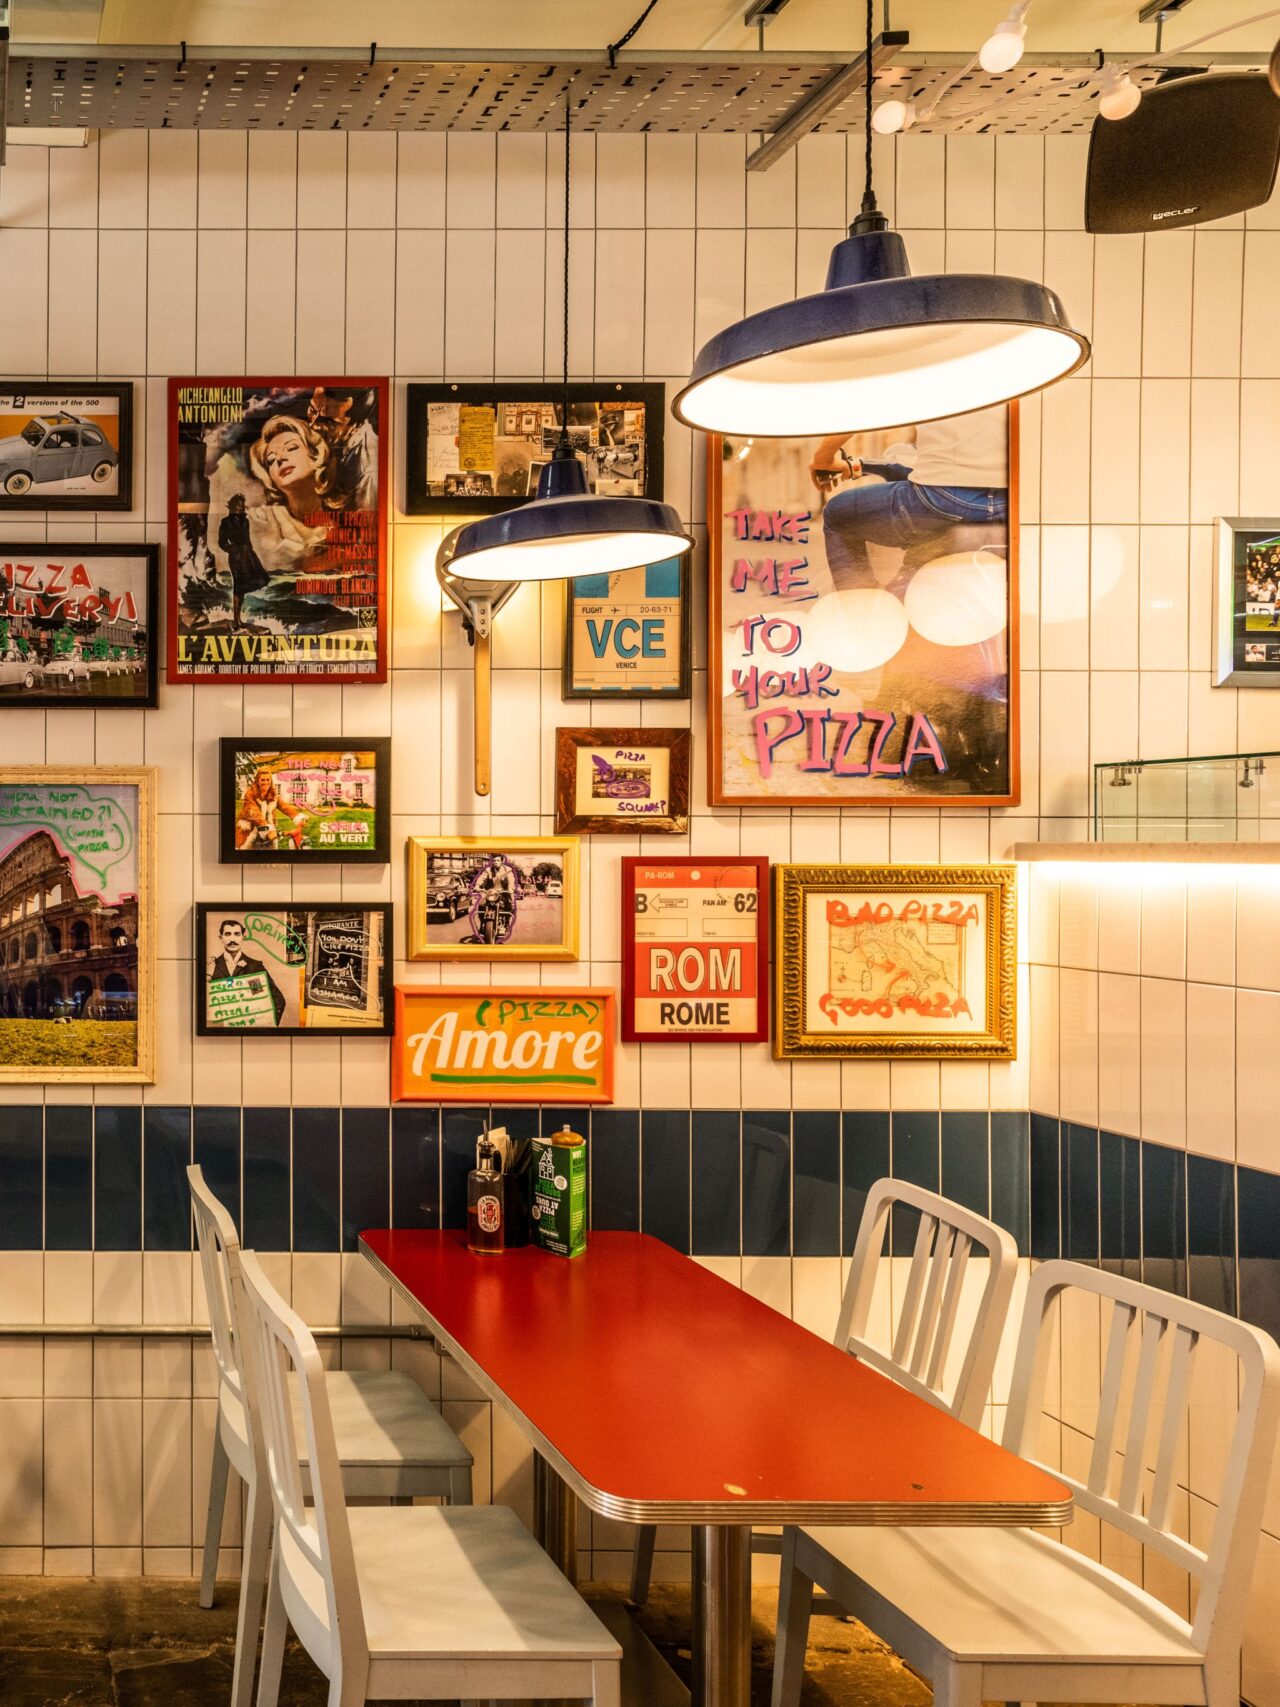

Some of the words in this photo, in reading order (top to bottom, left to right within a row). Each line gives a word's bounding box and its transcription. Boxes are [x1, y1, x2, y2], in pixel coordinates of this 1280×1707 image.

[178, 387, 242, 404] MICHELANGELO
[178, 405, 243, 423] ANTONIONI
[724, 508, 812, 544] TAKE
[731, 557, 818, 601] ME
[586, 618, 666, 659] VCE
[730, 614, 802, 657] TO
[177, 635, 377, 661] L'AVVENTURA
[731, 662, 840, 709] YOUR
[755, 706, 949, 779] PIZZA
[287, 759, 311, 769] THE
[615, 750, 646, 762] PIZZA
[320, 834, 336, 843] AU
[340, 834, 369, 843] VERT
[645, 871, 675, 880] PA-ROM
[734, 893, 757, 913] 62
[322, 933, 336, 942] YOU
[649, 946, 742, 992] ROM
[660, 1002, 730, 1025] ROME
[406, 1011, 603, 1077] Amore
